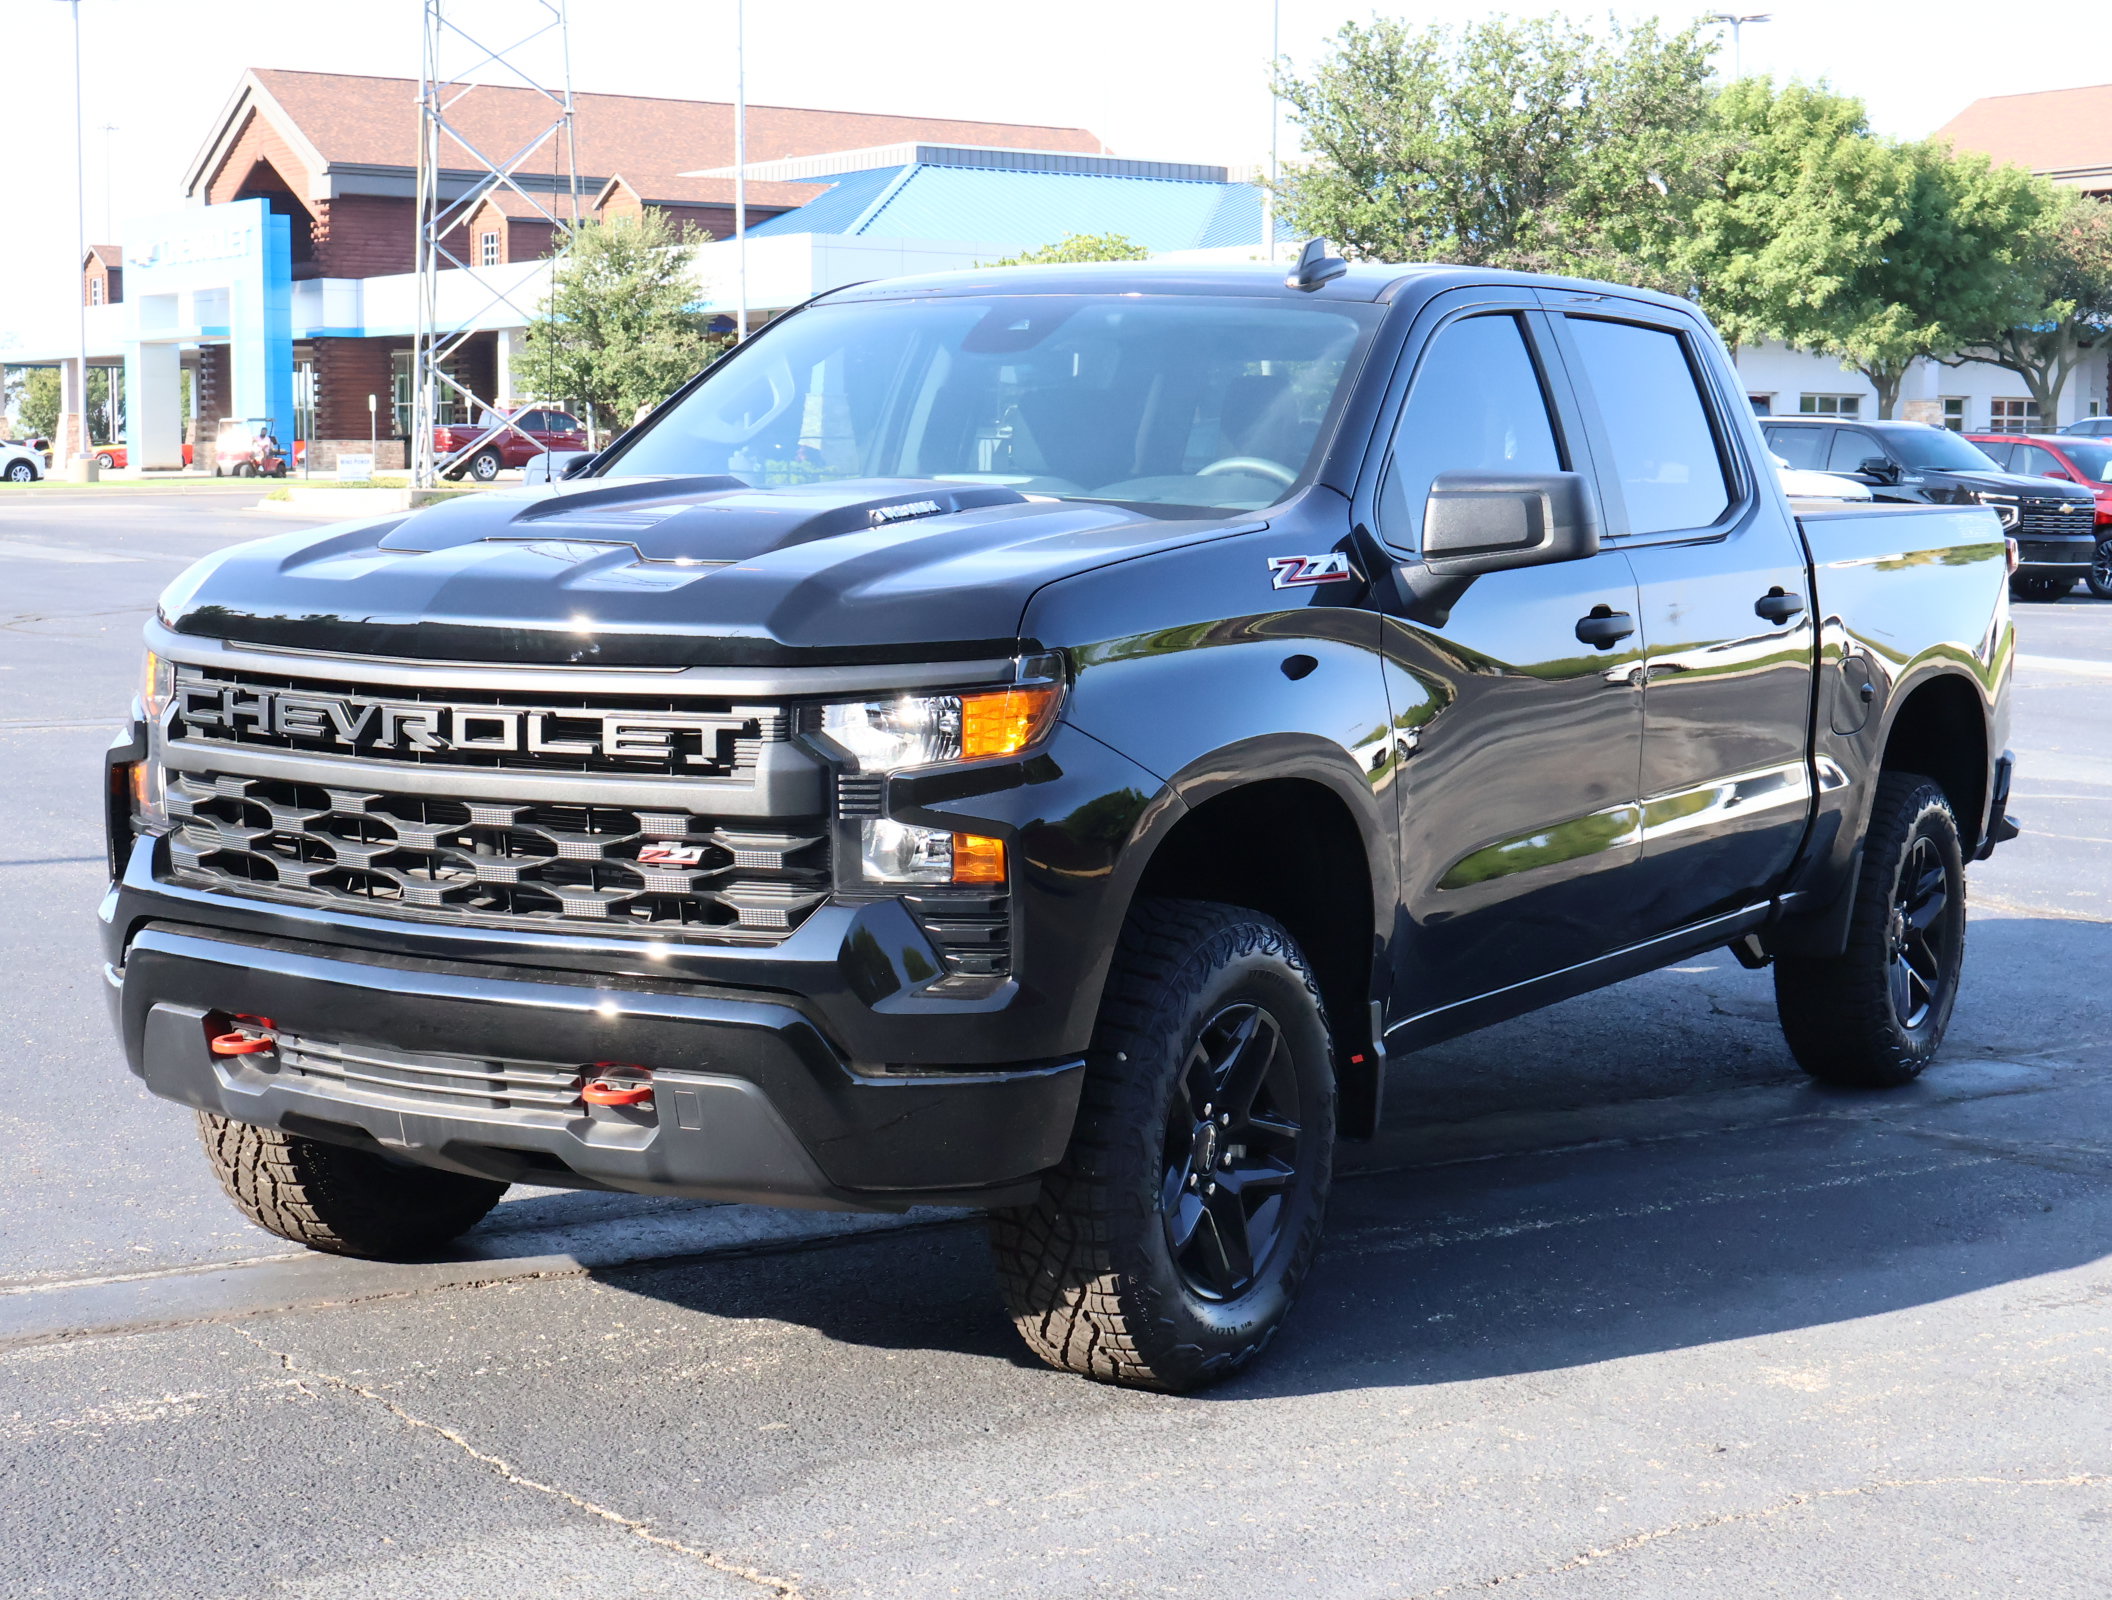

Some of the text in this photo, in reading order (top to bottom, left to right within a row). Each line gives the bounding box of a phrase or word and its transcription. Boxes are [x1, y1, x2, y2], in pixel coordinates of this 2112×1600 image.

[1267, 551, 1350, 590] Z71
[179, 686, 746, 759] CHEVROLET
[636, 843, 708, 865] Z71
